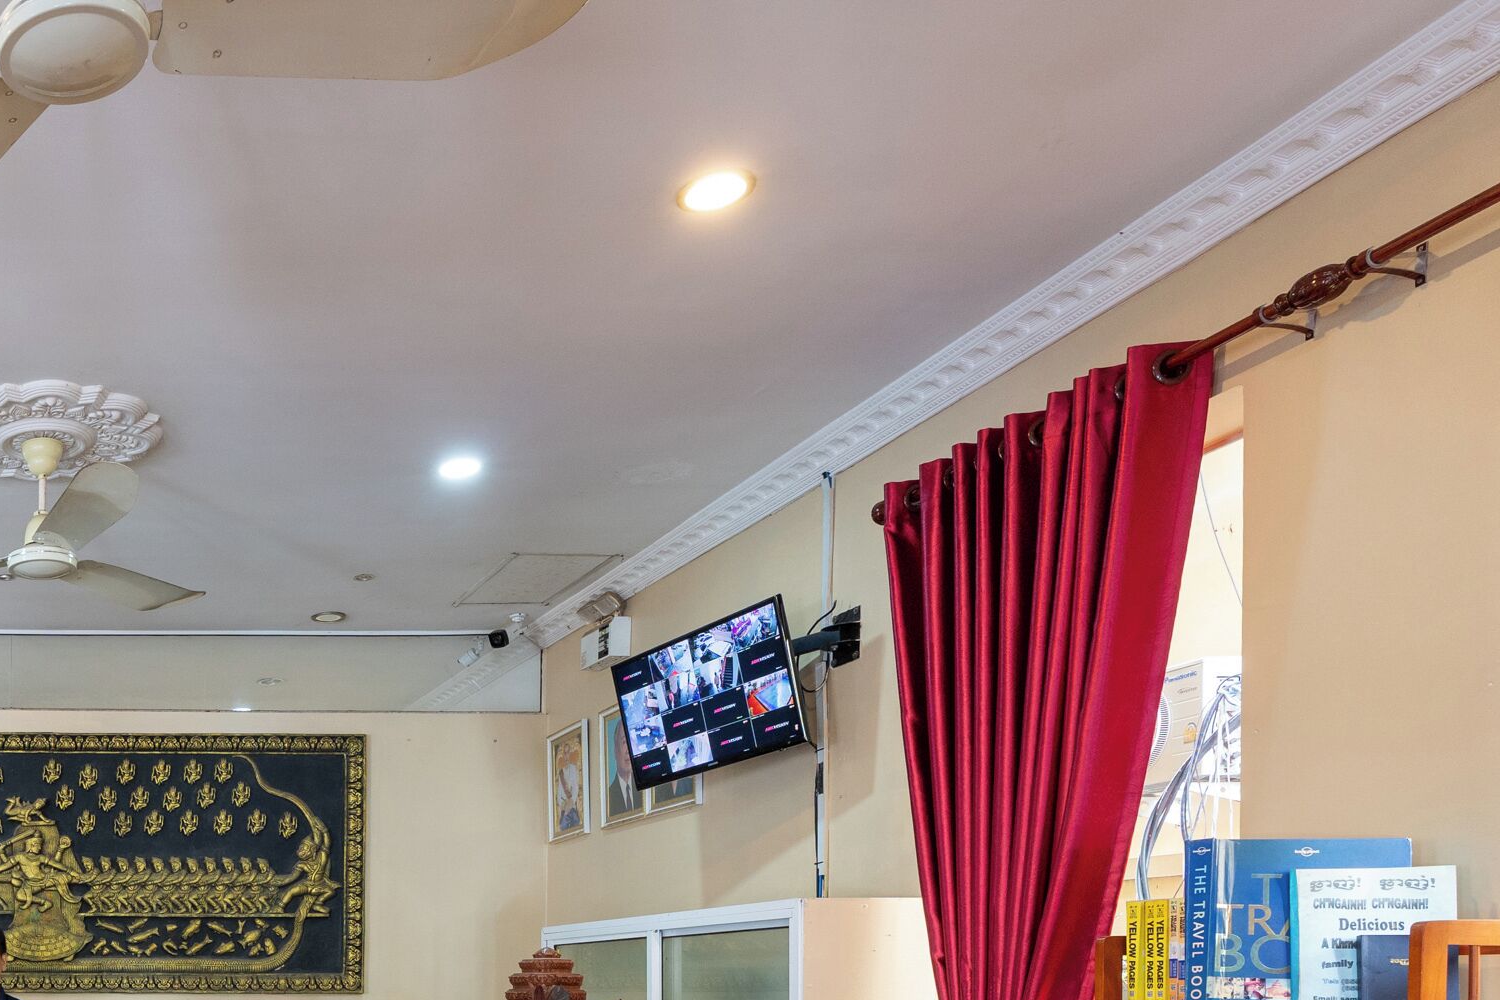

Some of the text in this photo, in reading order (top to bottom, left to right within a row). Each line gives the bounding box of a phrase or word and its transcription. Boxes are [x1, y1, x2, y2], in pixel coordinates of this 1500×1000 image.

[1194, 865, 1207, 894] THE
[1191, 901, 1206, 958] TRAVEL
[1338, 918, 1405, 931] Delicious
[1129, 921, 1137, 958] YELLOW
[1321, 937, 1329, 949] A
[1156, 920, 1164, 989] YELLOW PAGES
[1321, 959, 1354, 969] family
